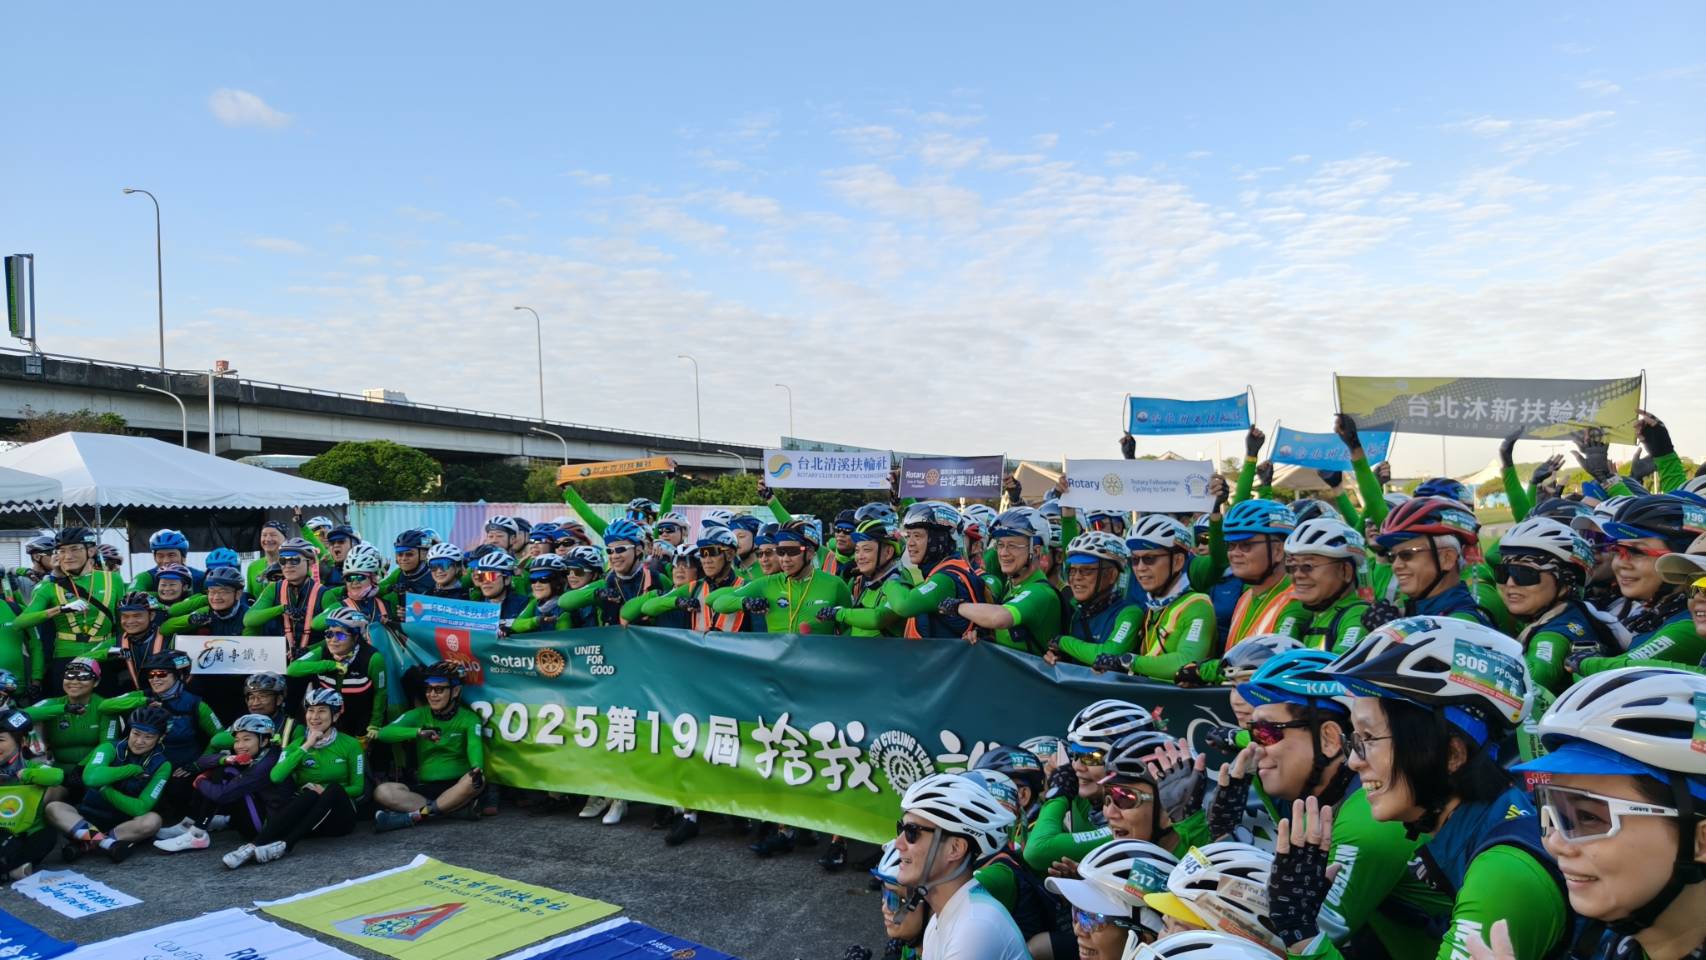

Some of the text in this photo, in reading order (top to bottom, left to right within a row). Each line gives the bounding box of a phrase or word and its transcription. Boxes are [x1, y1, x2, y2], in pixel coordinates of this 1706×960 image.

[1407, 396, 1600, 424] 台北沐新扶輪社
[797, 455, 888, 472] 台北清溪扶輪社
[905, 470, 926, 480] Rotary
[1068, 477, 1100, 491] Rotary
[574, 645, 601, 655] UNITE
[491, 655, 535, 670] Rotary
[586, 655, 603, 664] FOR
[1455, 652, 1489, 674] 306
[590, 665, 615, 675] GOOD
[880, 730, 916, 752] CYCLING
[1130, 869, 1155, 887] 217
